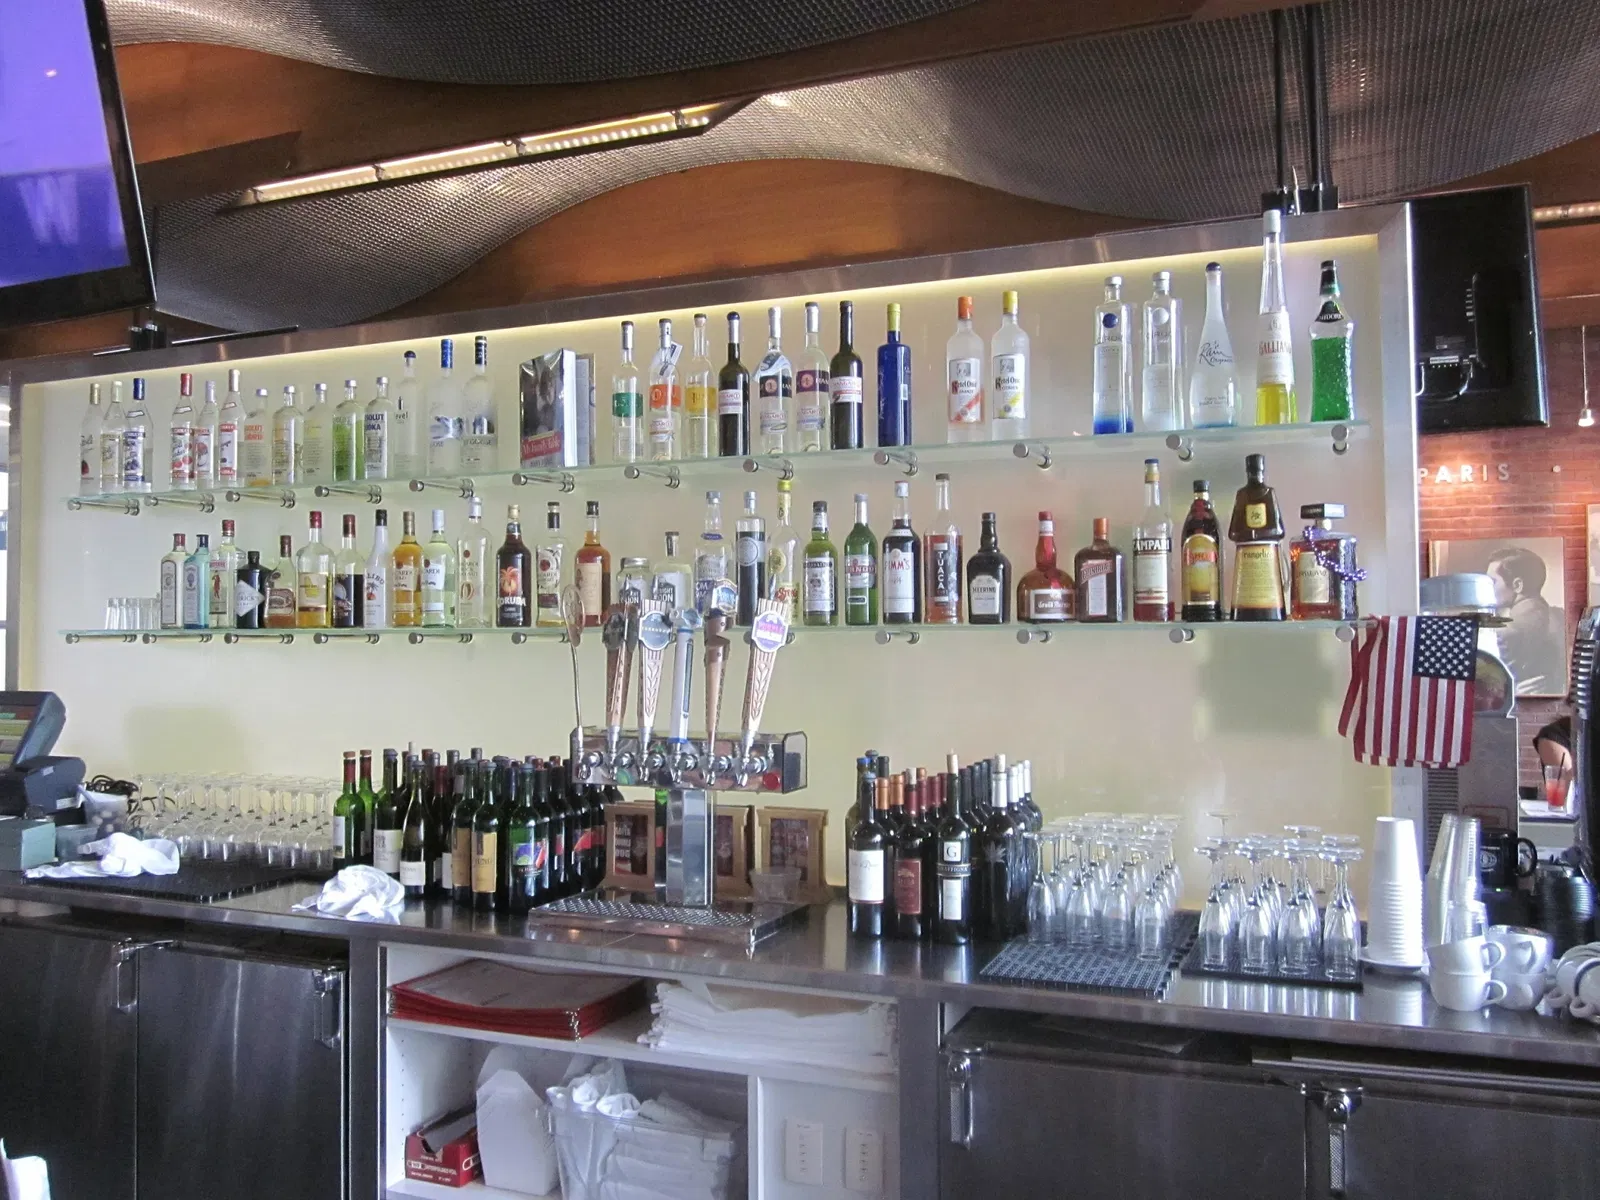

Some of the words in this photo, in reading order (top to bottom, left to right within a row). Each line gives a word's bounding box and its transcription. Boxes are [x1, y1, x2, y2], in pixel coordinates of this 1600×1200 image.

[1417, 463, 1510, 484] PARIS
[884, 558, 911, 571] PIMM'S
[937, 551, 945, 590] TUACA
[946, 846, 957, 858] G
